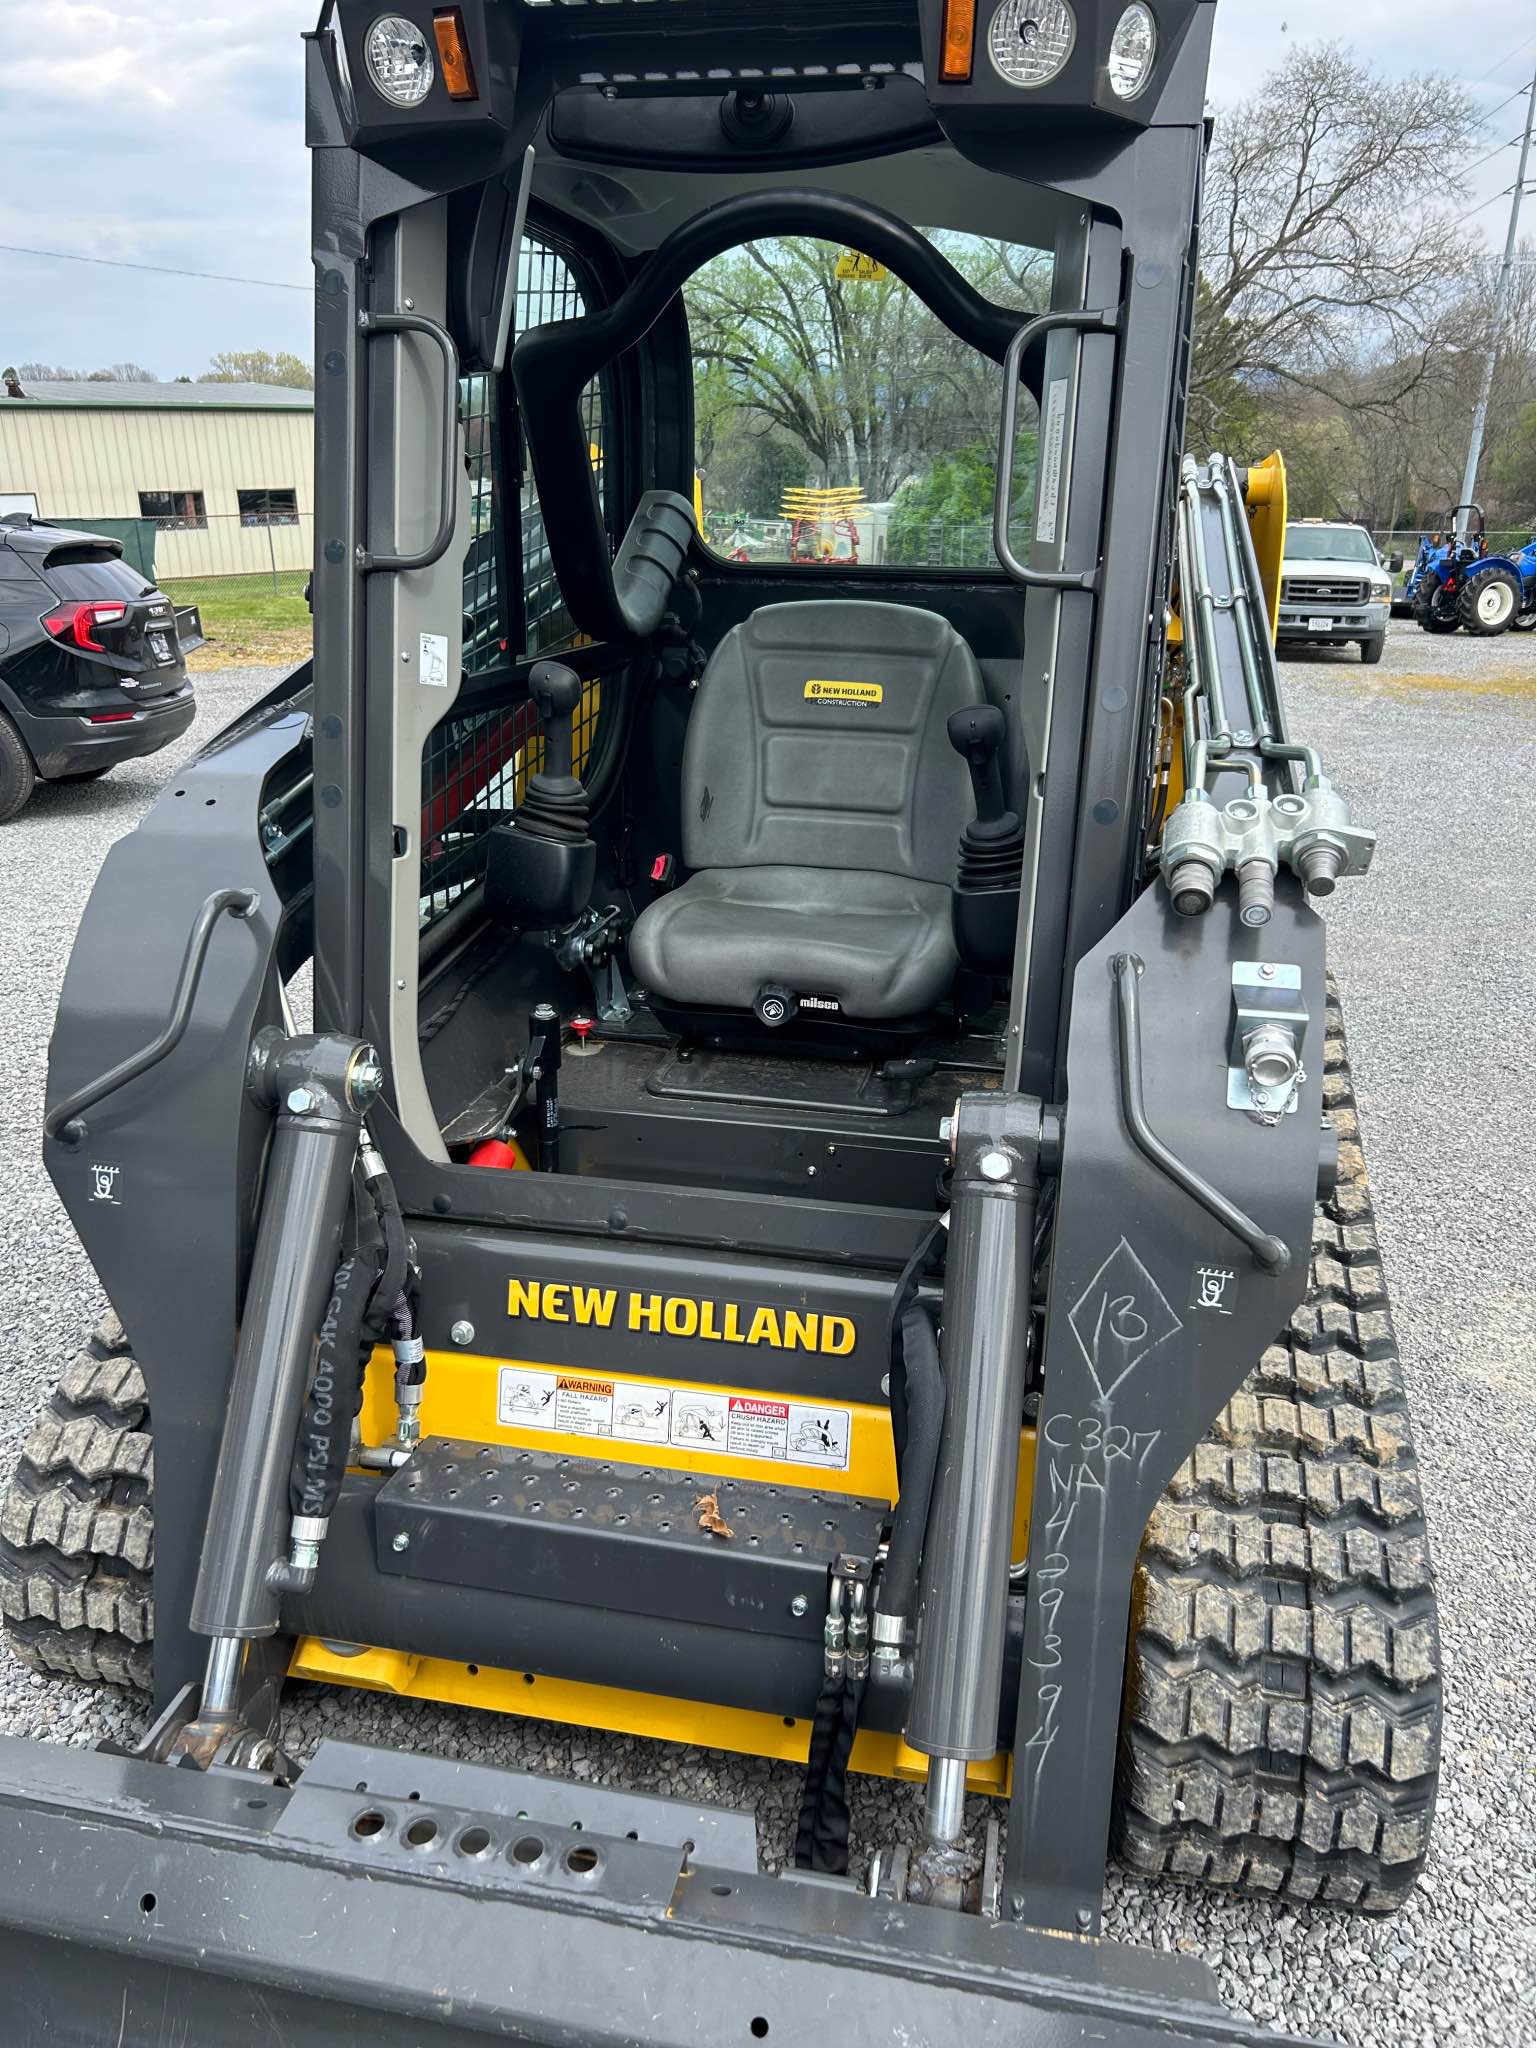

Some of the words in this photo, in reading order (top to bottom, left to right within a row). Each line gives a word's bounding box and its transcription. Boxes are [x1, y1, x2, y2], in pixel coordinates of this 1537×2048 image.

[822, 687, 840, 695] NEW
[841, 688, 877, 697] HOLLAND
[817, 698, 867, 707] CONSTRUCTION
[800, 997, 839, 1011] milsco
[507, 1279, 618, 1328] NEW
[628, 1292, 857, 1356] HOLLAND
[312, 1359, 335, 1426] 4000
[567, 1380, 612, 1393] WARNING
[562, 1391, 578, 1399] FALL
[580, 1394, 608, 1402] HAZARD
[744, 1402, 786, 1416] DANGER
[731, 1413, 755, 1421] CRUSH
[757, 1417, 786, 1425] HAZARD
[1044, 1413, 1161, 1469] C327
[307, 1433, 332, 1468] PSI
